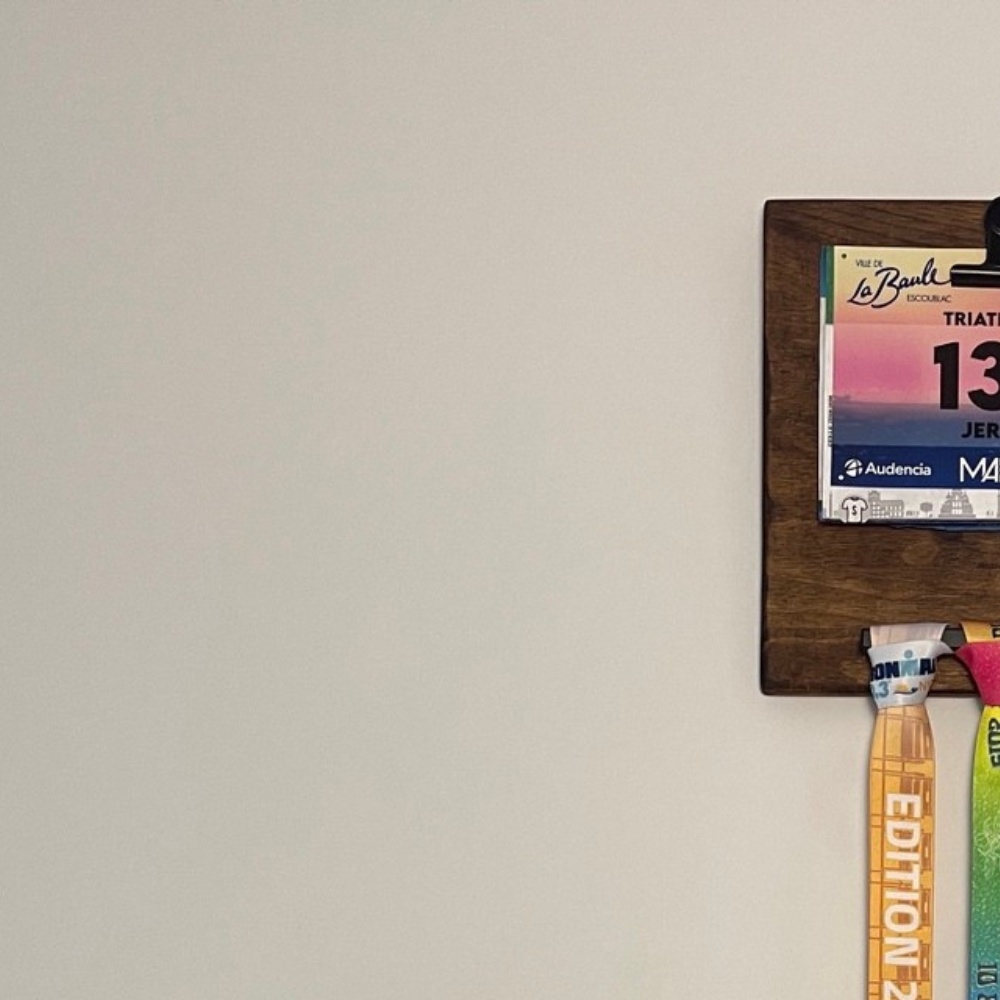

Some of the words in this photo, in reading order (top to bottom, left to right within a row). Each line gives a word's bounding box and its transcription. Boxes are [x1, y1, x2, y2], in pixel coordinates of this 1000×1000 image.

[855, 259, 872, 268] VILLE
[873, 259, 883, 267] DE
[847, 278, 873, 305] La
[864, 461, 932, 476] Audencia
[883, 792, 922, 967] EDITION
[977, 962, 997, 988] 10
